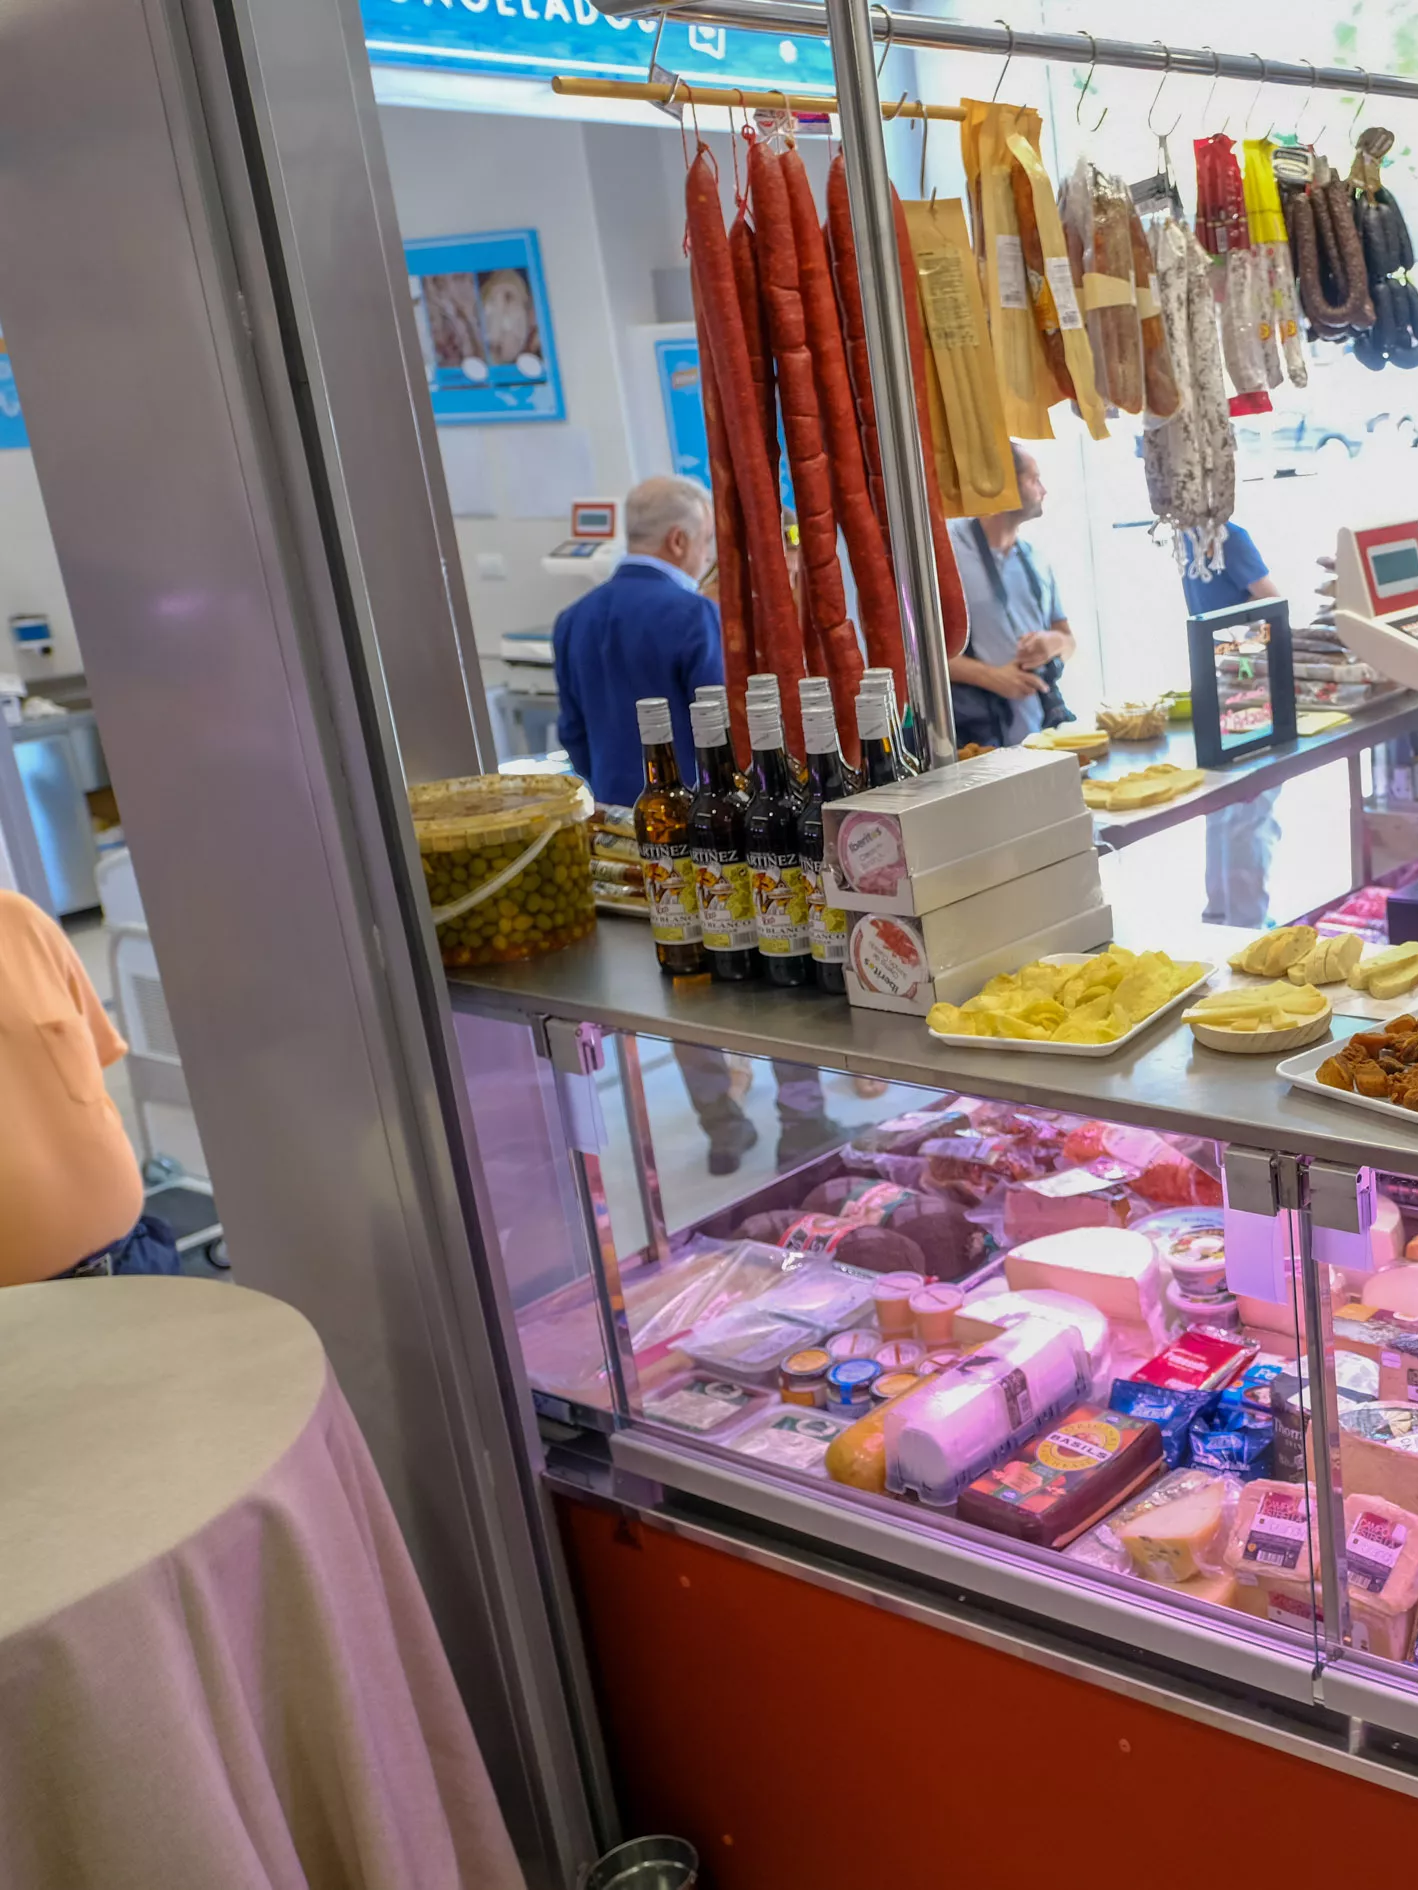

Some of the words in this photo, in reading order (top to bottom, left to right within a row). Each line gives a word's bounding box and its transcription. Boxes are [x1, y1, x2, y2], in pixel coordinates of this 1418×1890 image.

[849, 826, 882, 853] Iberitos
[863, 957, 900, 994] Iberitos
[1050, 1434, 1109, 1460] BASILS
